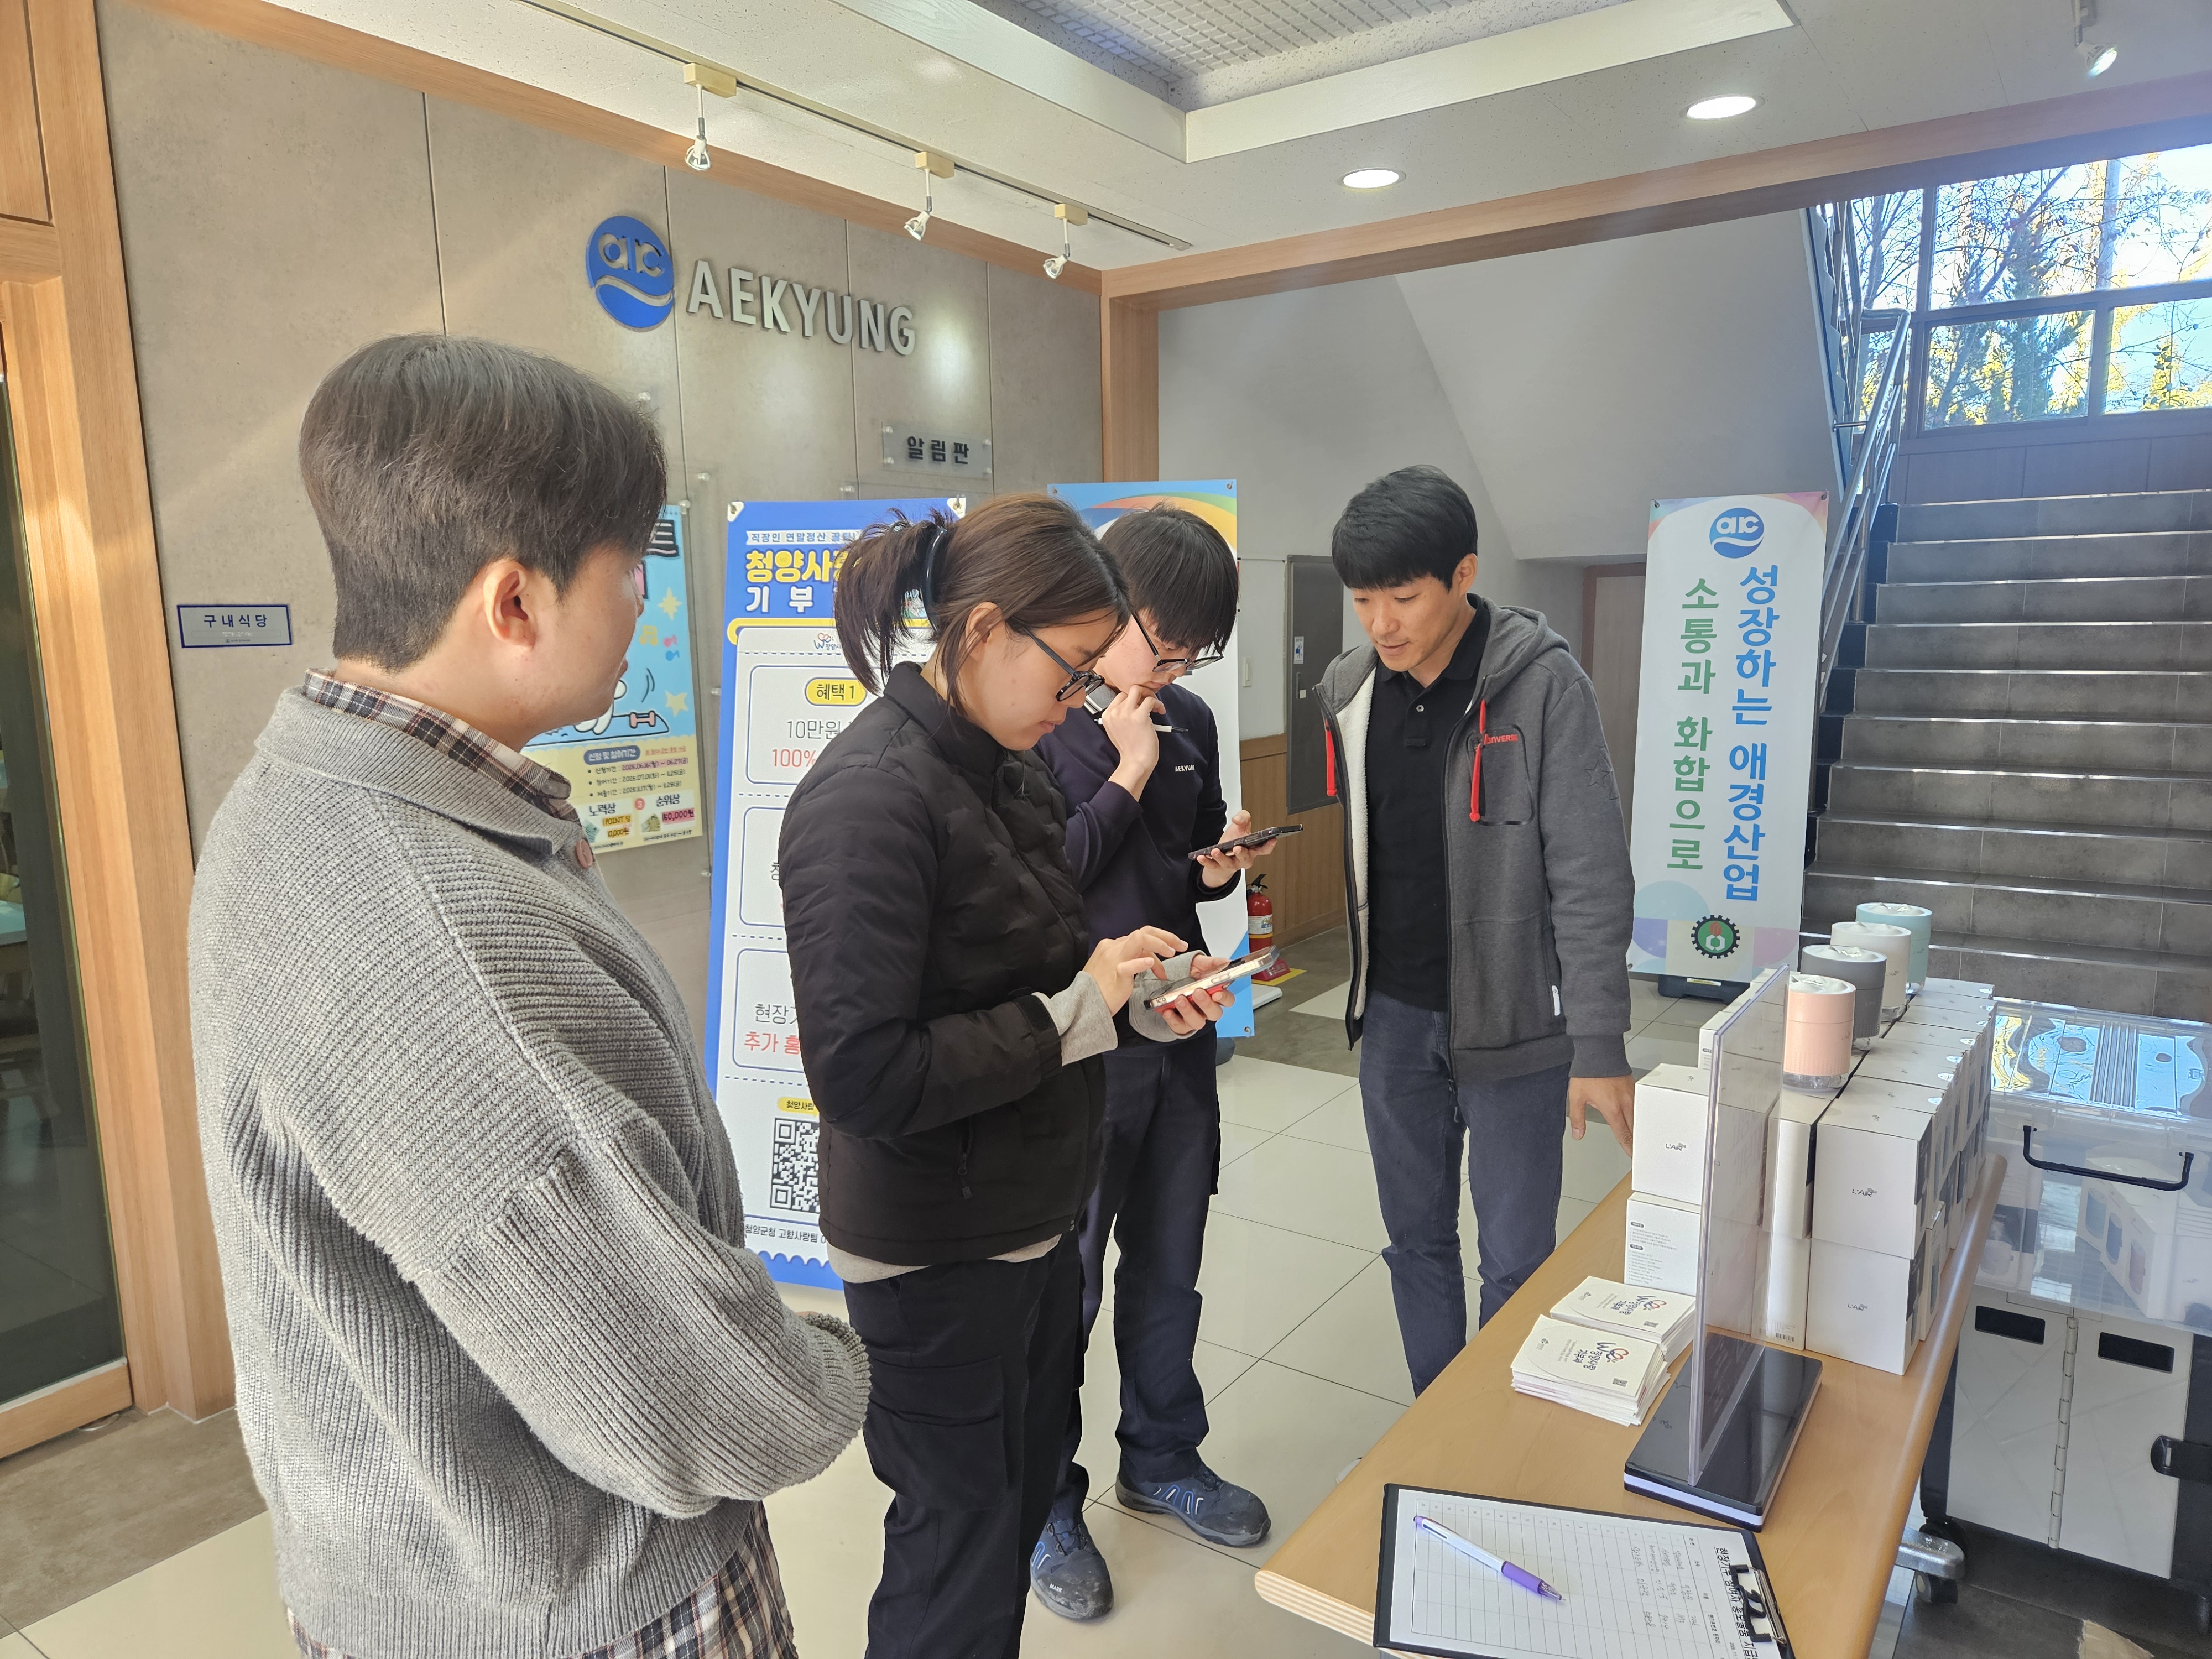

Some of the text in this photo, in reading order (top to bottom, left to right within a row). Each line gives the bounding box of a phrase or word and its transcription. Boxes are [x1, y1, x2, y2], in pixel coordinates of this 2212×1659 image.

[686, 259, 916, 356] AEKYUNG
[907, 436, 969, 465] 알림판
[752, 533, 781, 542] 직장인
[786, 533, 826, 542] 연말정산
[204, 614, 267, 628] 구내식당
[816, 683, 855, 701] 혜택 1
[787, 720, 841, 739] 10만원
[1667, 578, 1719, 870] 소통과 화합으로
[1723, 565, 1780, 901] 성장하는 애경산업
[589, 753, 602, 761] 신청
[773, 748, 817, 768] 100%
[656, 794, 681, 807] 순위상
[589, 803, 617, 817] 노력상
[605, 817, 623, 825] POINT
[744, 1031, 801, 1055] 추가 홍
[1852, 1188, 1872, 1197] L'AIR
[745, 1223, 776, 1238] 청양군청
[778, 1228, 818, 1244] 고향사랑팀
[1744, 1641, 1759, 1659] 지급
